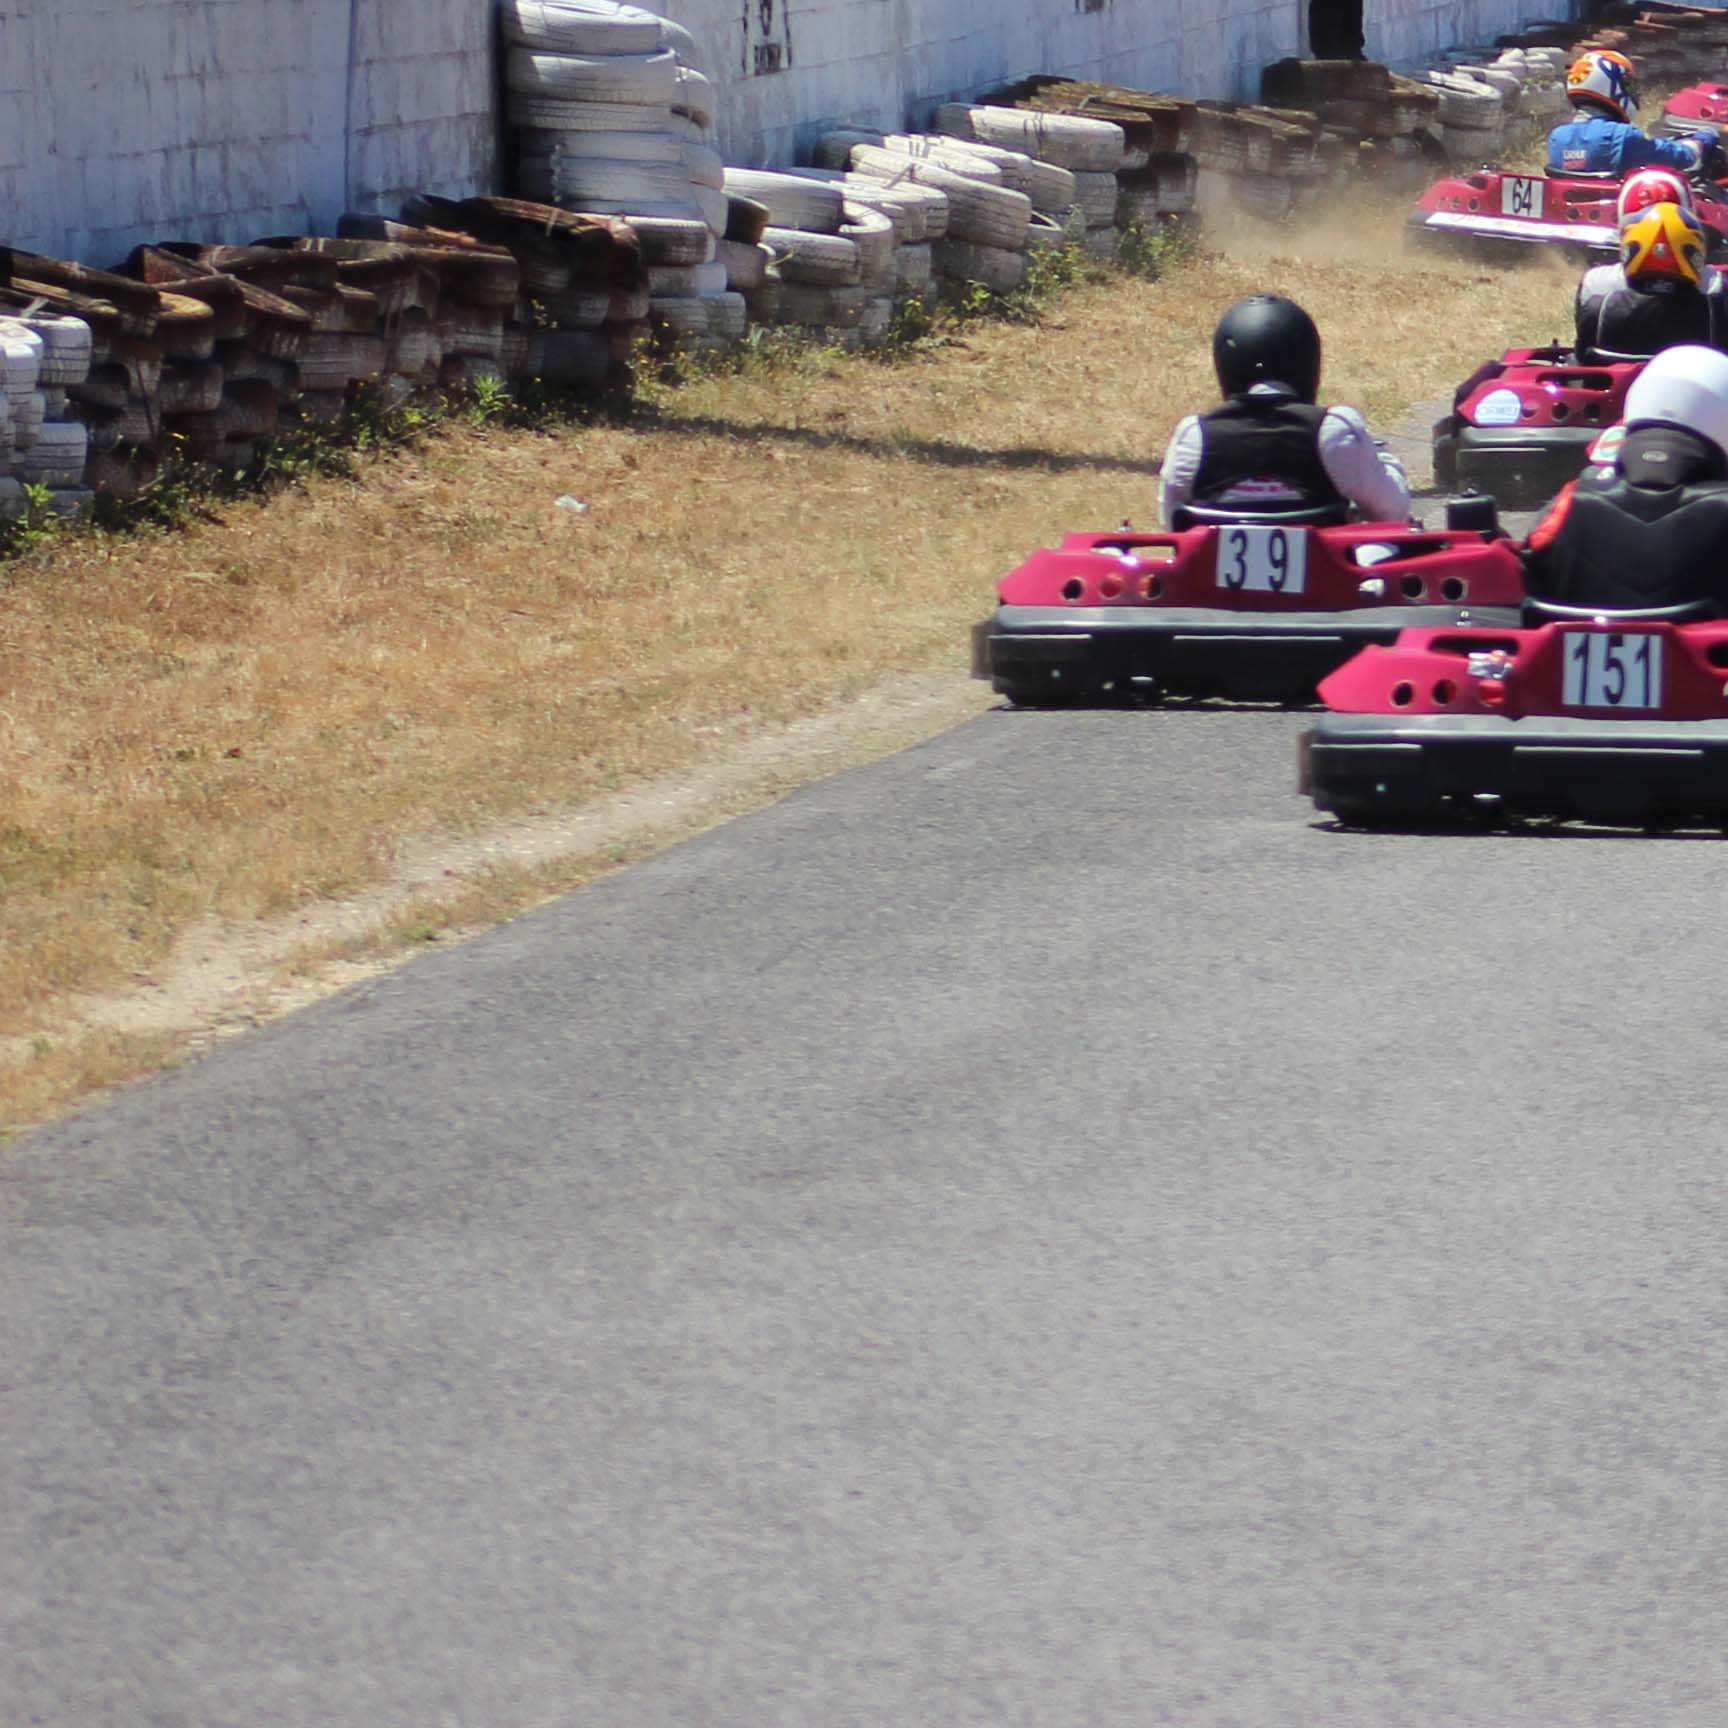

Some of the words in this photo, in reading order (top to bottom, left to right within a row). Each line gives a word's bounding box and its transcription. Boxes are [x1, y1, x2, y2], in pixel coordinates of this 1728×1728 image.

[1512, 178, 1533, 216] 64
[1226, 528, 1288, 590] 39
[1573, 633, 1651, 705] 151
